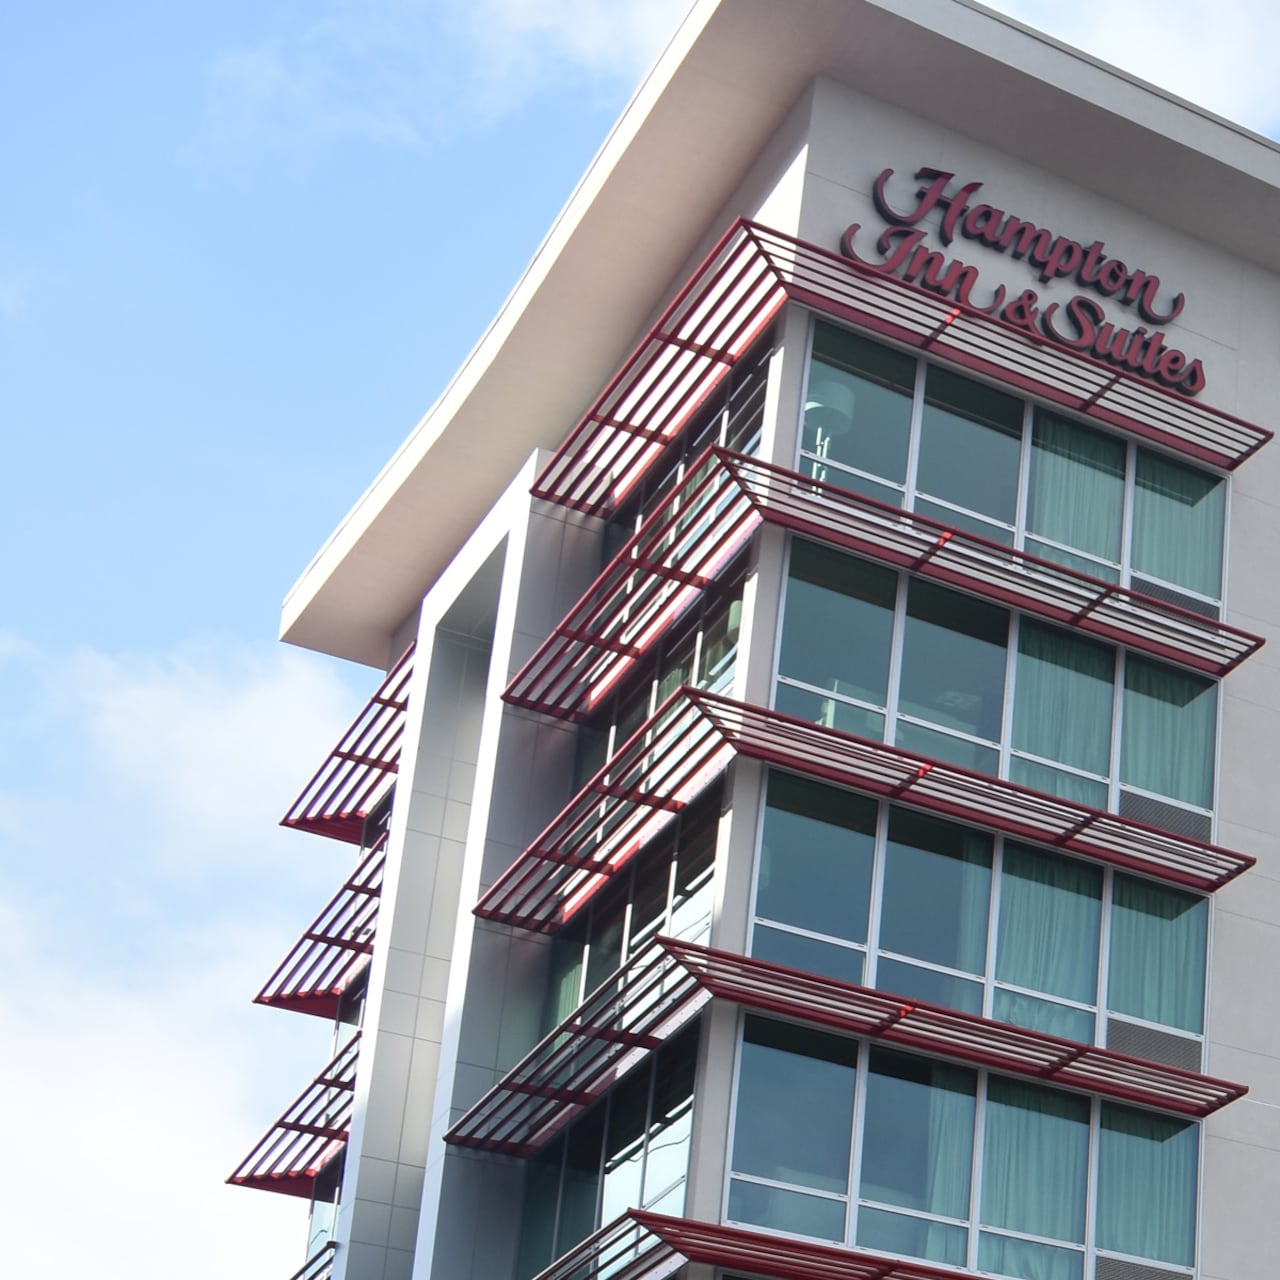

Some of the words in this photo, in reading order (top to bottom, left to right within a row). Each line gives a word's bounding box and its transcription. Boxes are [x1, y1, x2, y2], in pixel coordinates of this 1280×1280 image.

[840, 223, 1006, 315] Inn
[1001, 289, 1041, 344] &
[1041, 295, 1207, 396] Suites
[873, 167, 1186, 326] Hampton
